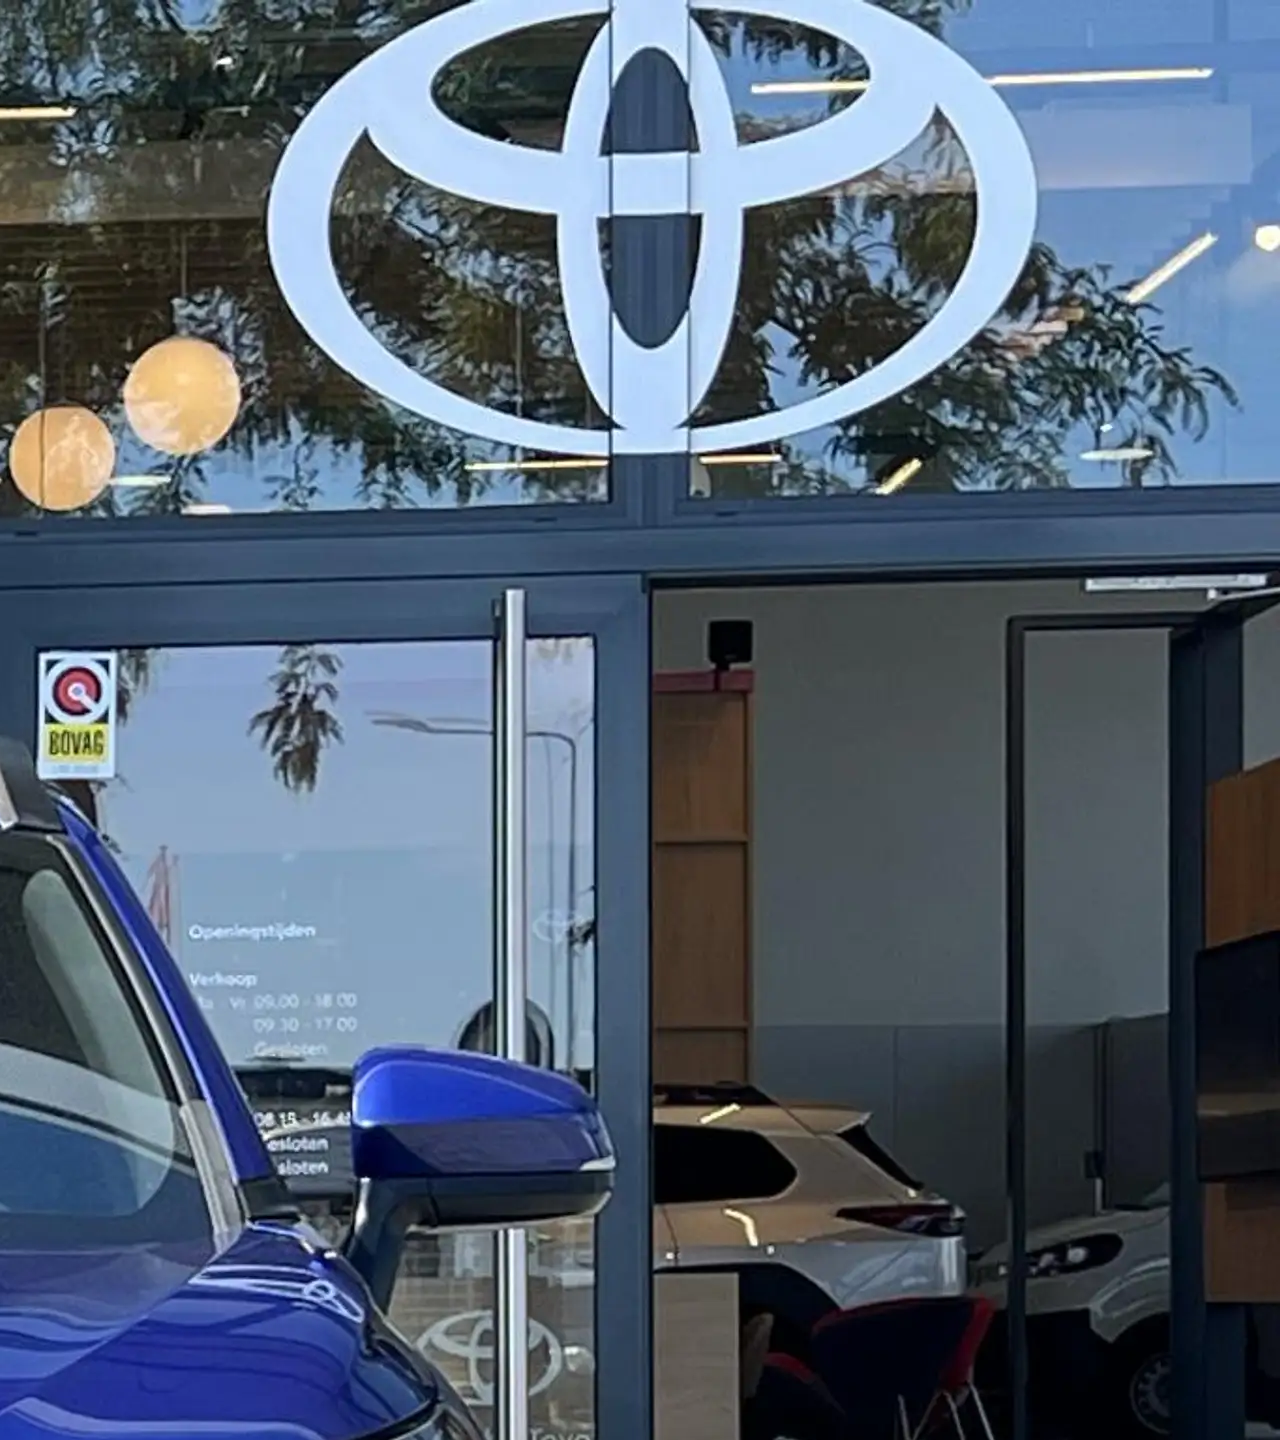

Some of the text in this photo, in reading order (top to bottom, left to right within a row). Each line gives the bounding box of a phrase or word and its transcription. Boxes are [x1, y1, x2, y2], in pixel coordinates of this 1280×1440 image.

[49, 729, 104, 755] BOVAG
[189, 922, 316, 942] Openingstijden
[189, 972, 258, 989] Verkoop
[267, 1136, 329, 1152] esloten
[277, 1158, 329, 1176] sloten
